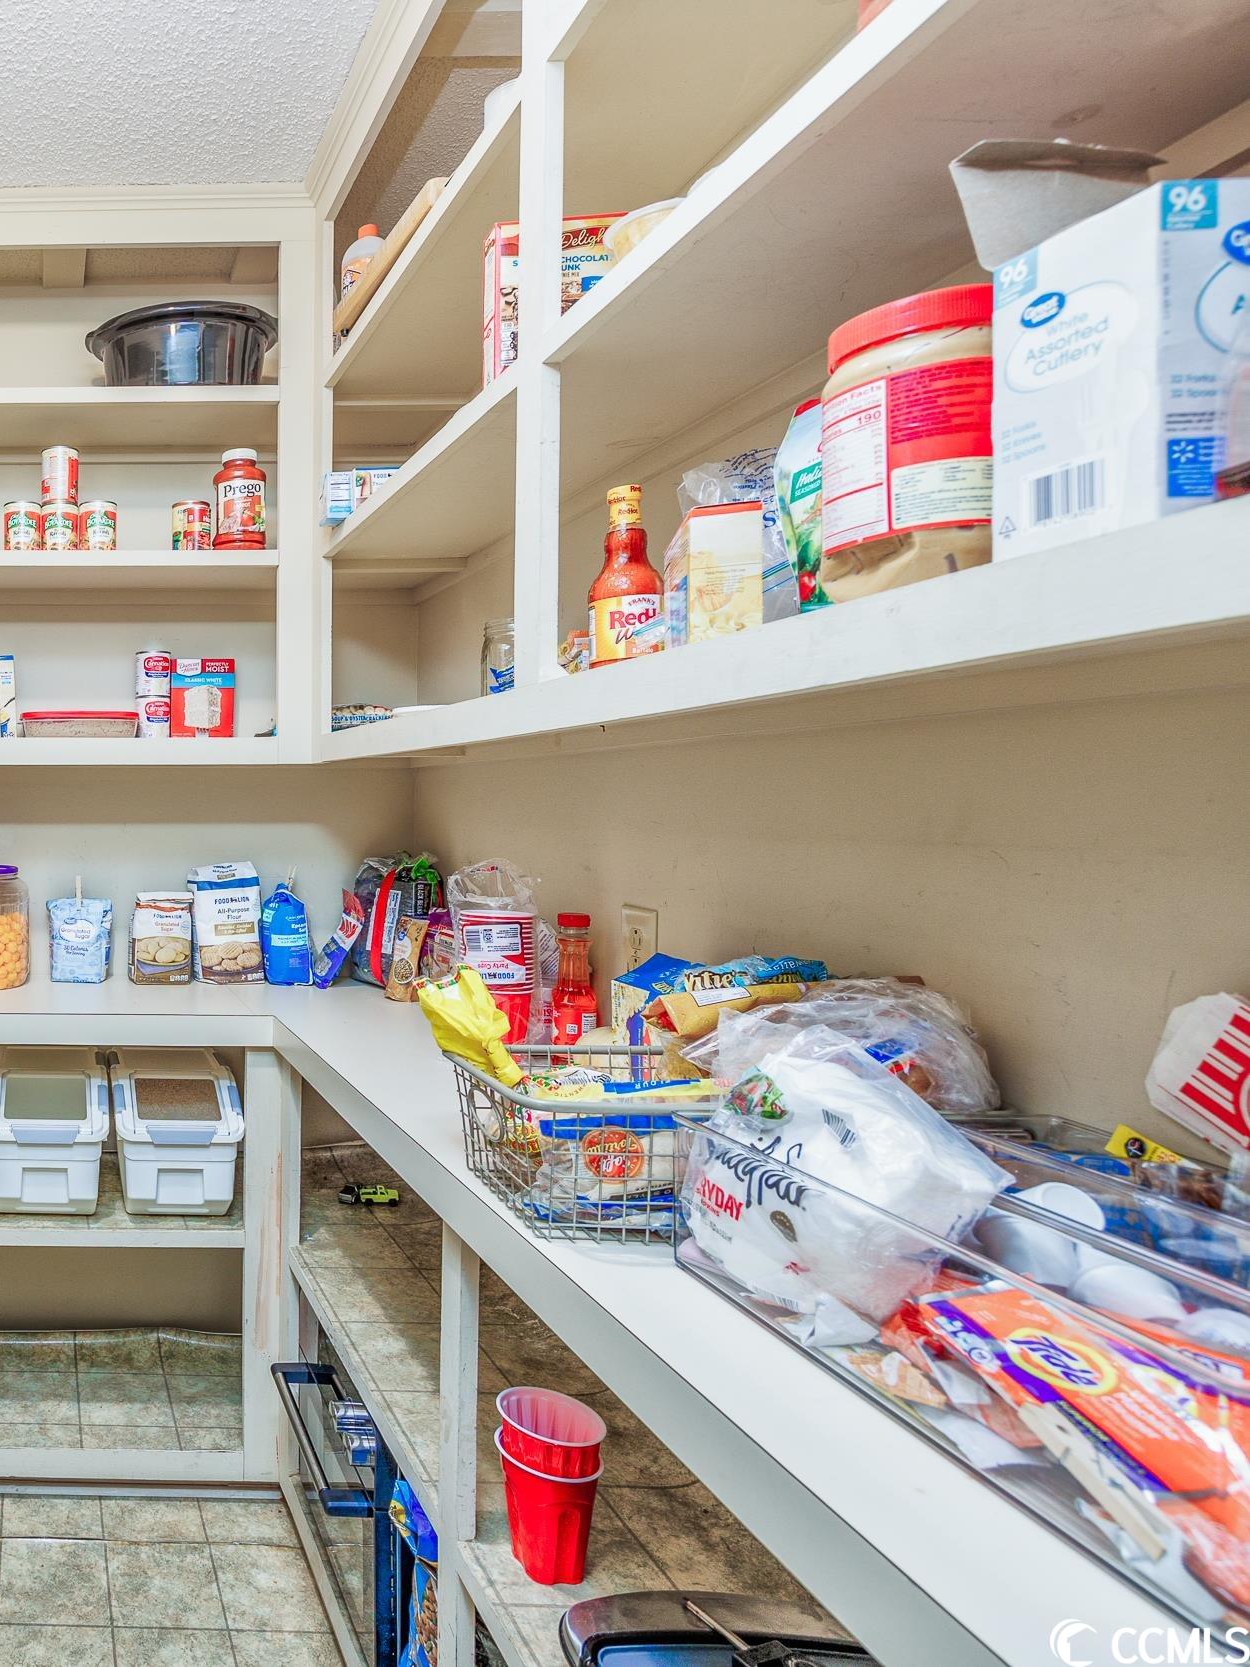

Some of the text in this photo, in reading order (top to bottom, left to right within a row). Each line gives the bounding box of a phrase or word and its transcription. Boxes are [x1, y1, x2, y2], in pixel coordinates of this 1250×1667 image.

[1168, 185, 1207, 214] 96
[999, 258, 1029, 290] 96
[1024, 315, 1109, 364] Assorted
[1032, 339, 1103, 377] Cutlery
[856, 410, 883, 426] 190
[223, 483, 262, 498] Prego
[628, 598, 656, 608] FRANK'S
[217, 907, 250, 915] All-Purpose
